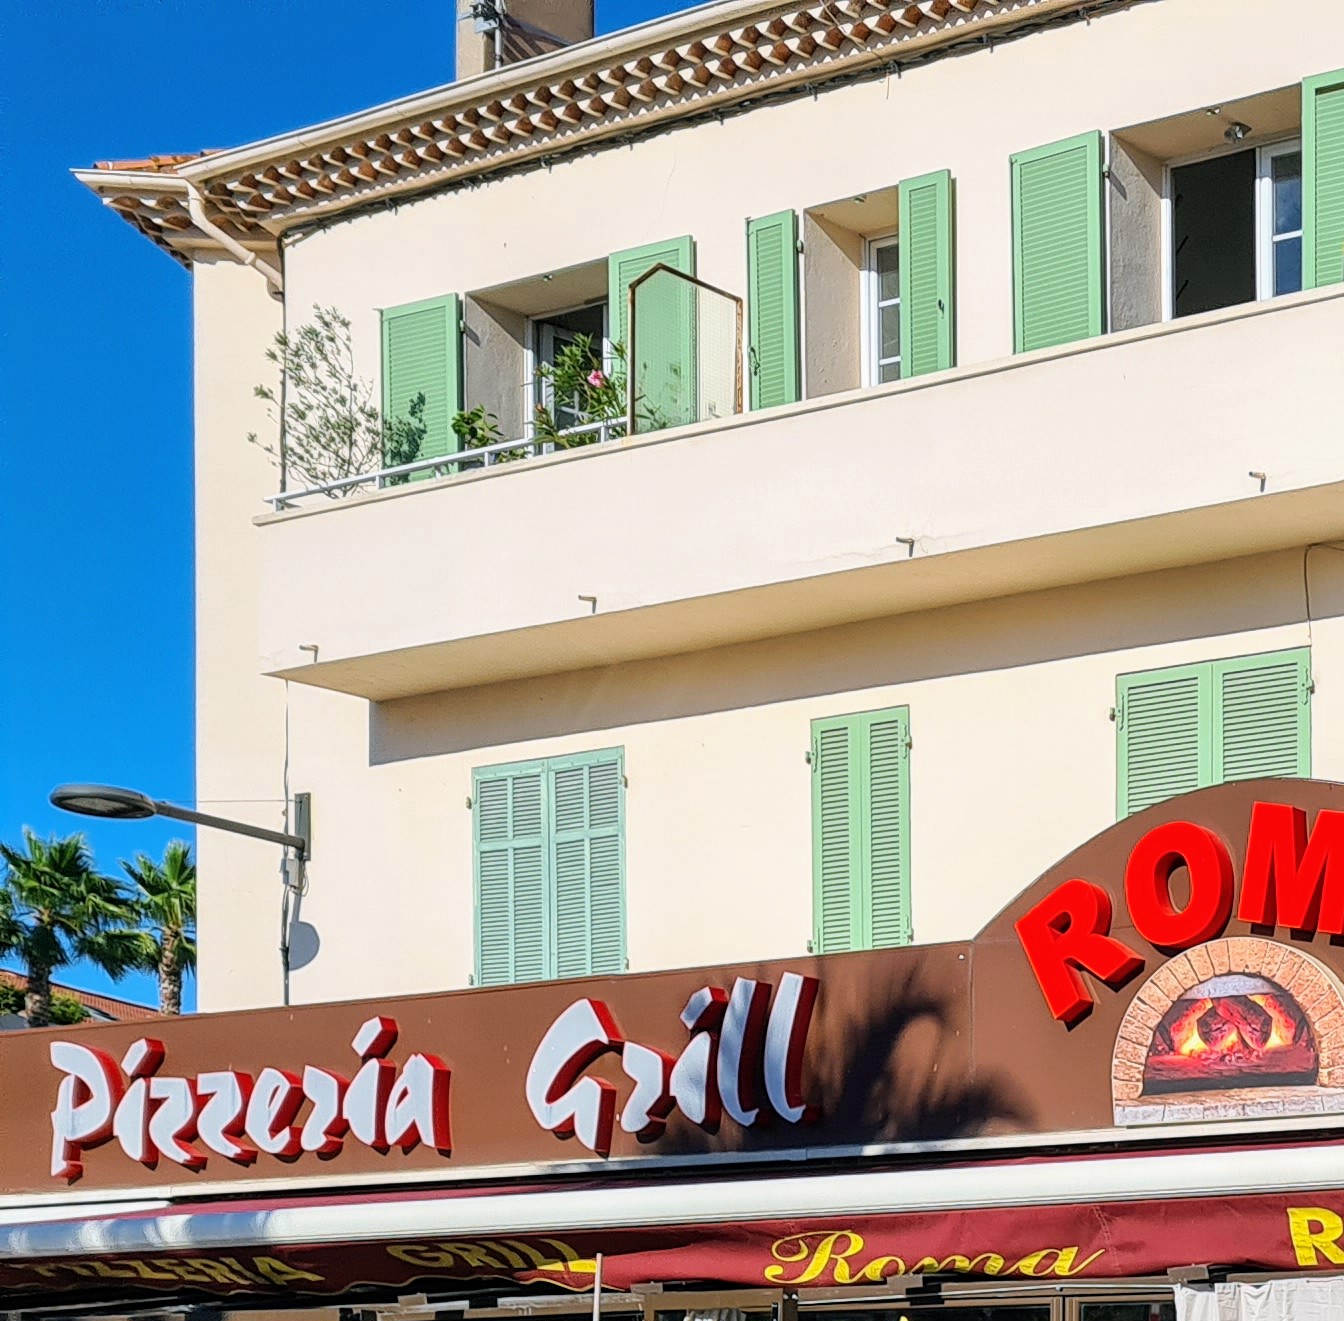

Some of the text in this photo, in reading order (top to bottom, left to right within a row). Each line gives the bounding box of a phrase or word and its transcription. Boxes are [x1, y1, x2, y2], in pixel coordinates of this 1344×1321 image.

[49, 971, 820, 1182] Pizzeria Grill
[762, 1229, 1107, 1286] Roma
